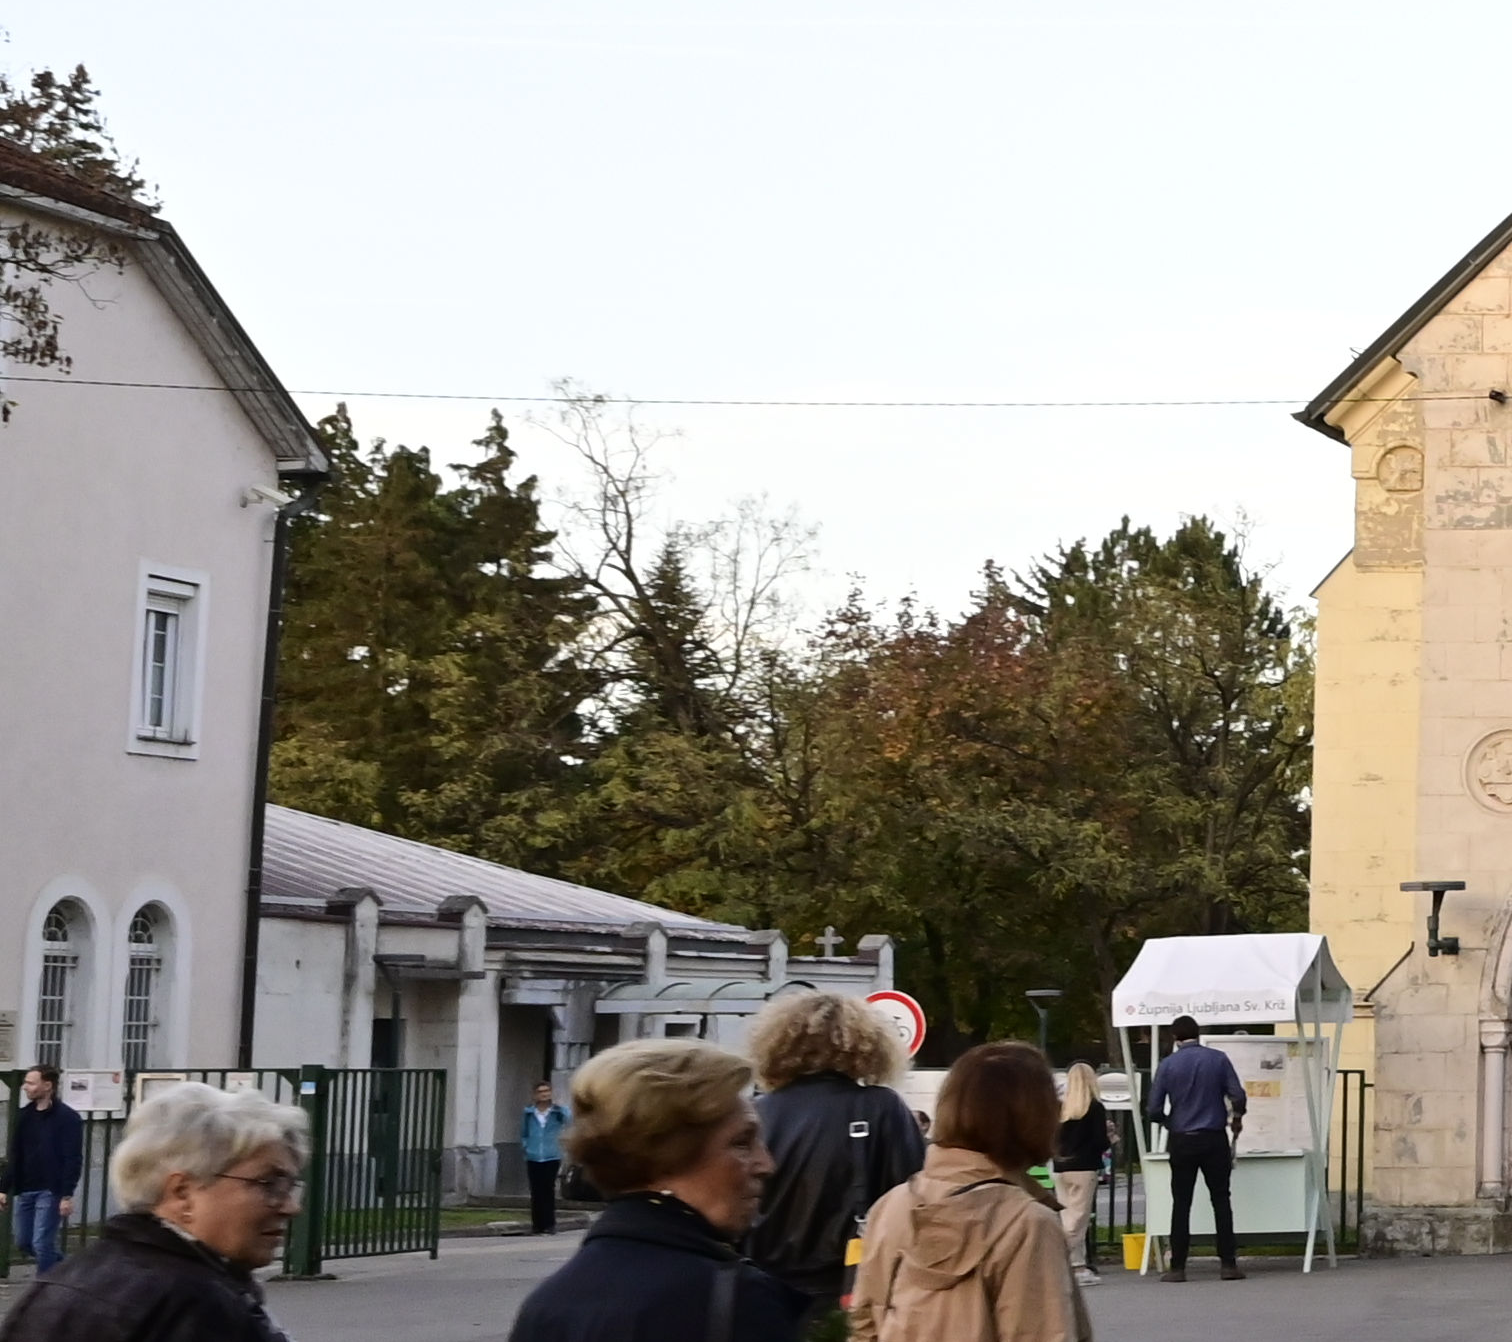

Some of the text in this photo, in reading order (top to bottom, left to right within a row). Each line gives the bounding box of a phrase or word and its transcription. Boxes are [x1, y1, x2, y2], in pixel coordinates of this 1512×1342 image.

[1138, 999, 1287, 1016] Župnija Ljubljana Sv. Križ
